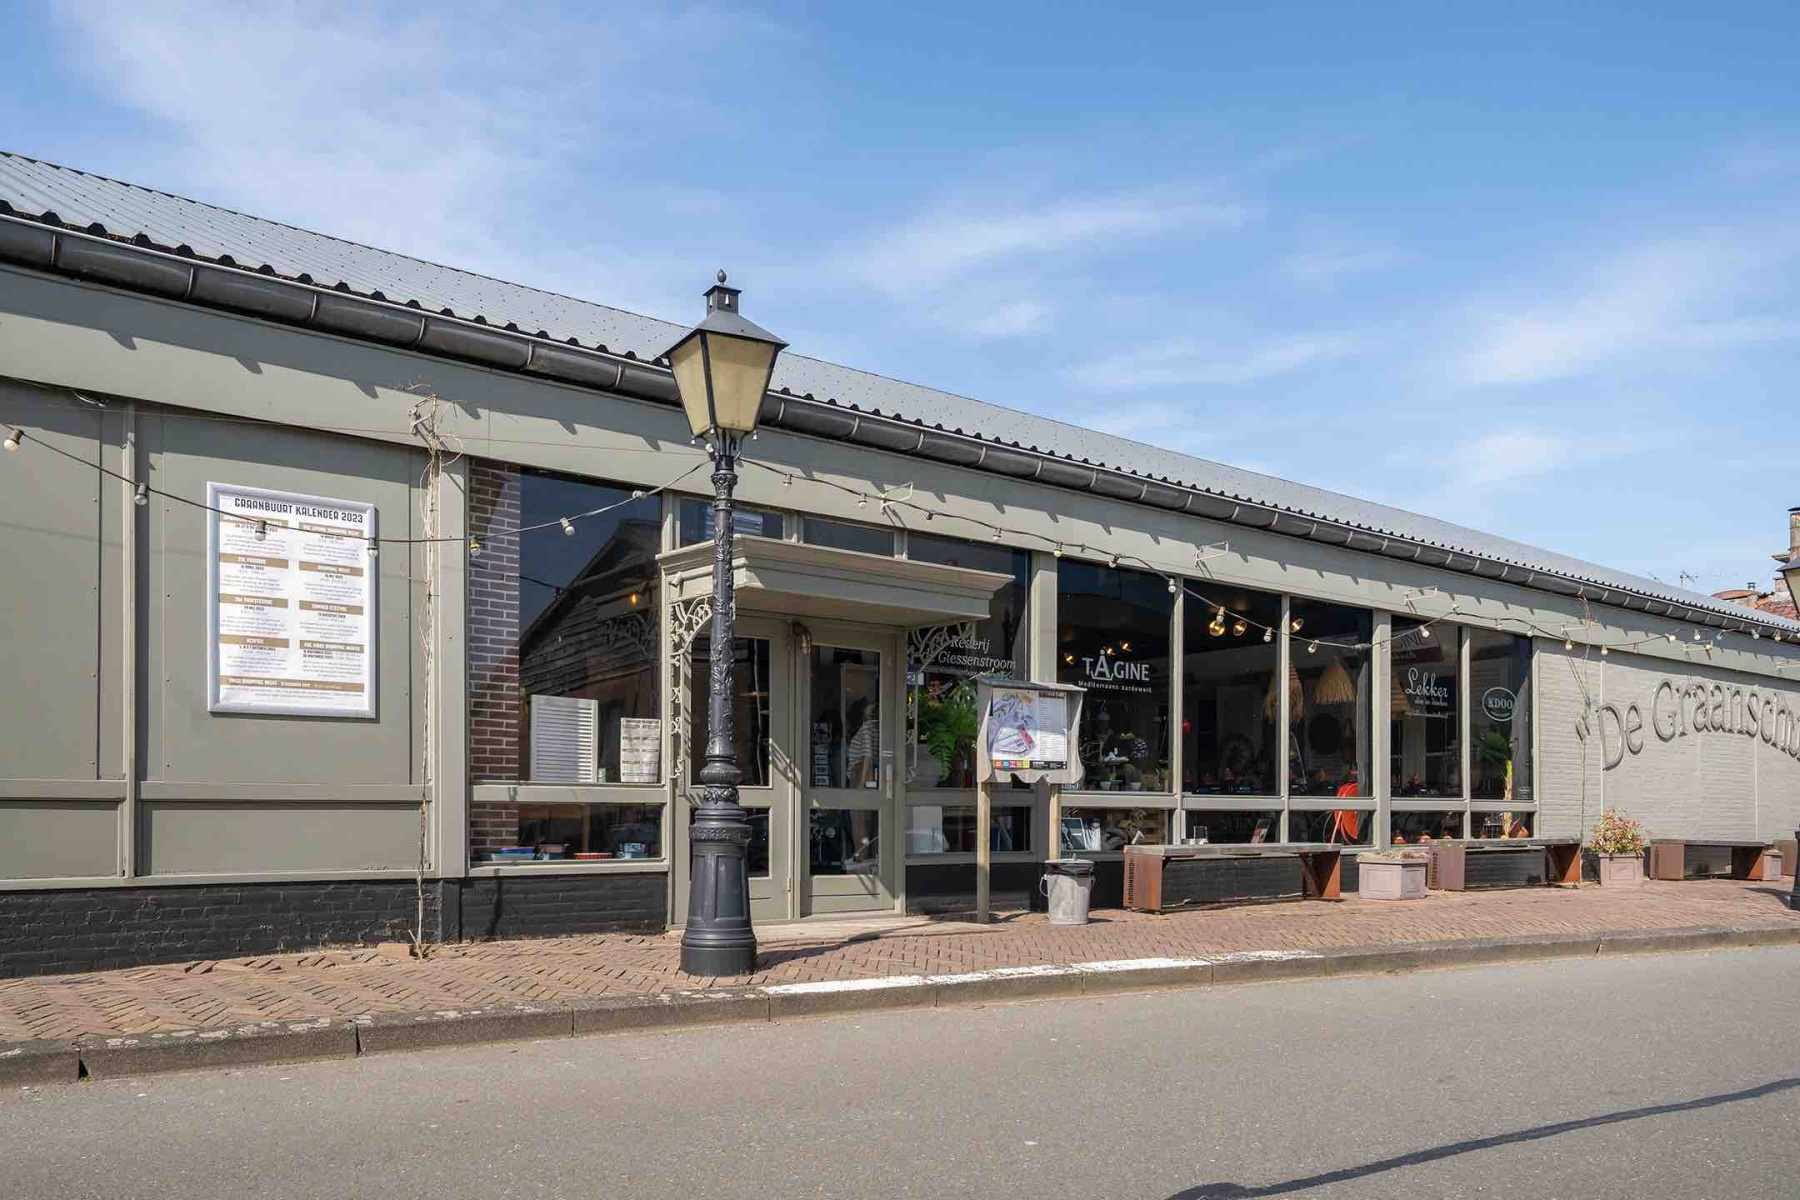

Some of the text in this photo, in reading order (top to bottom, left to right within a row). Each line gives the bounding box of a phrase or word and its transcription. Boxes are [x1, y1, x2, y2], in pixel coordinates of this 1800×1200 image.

[295, 506, 339, 520] KALENDER
[341, 512, 363, 523] 2023
[950, 635, 991, 654] Rederij
[938, 650, 1016, 669] Giessenstroom
[1405, 667, 1448, 697] Lekker
[1597, 702, 1644, 773] De
